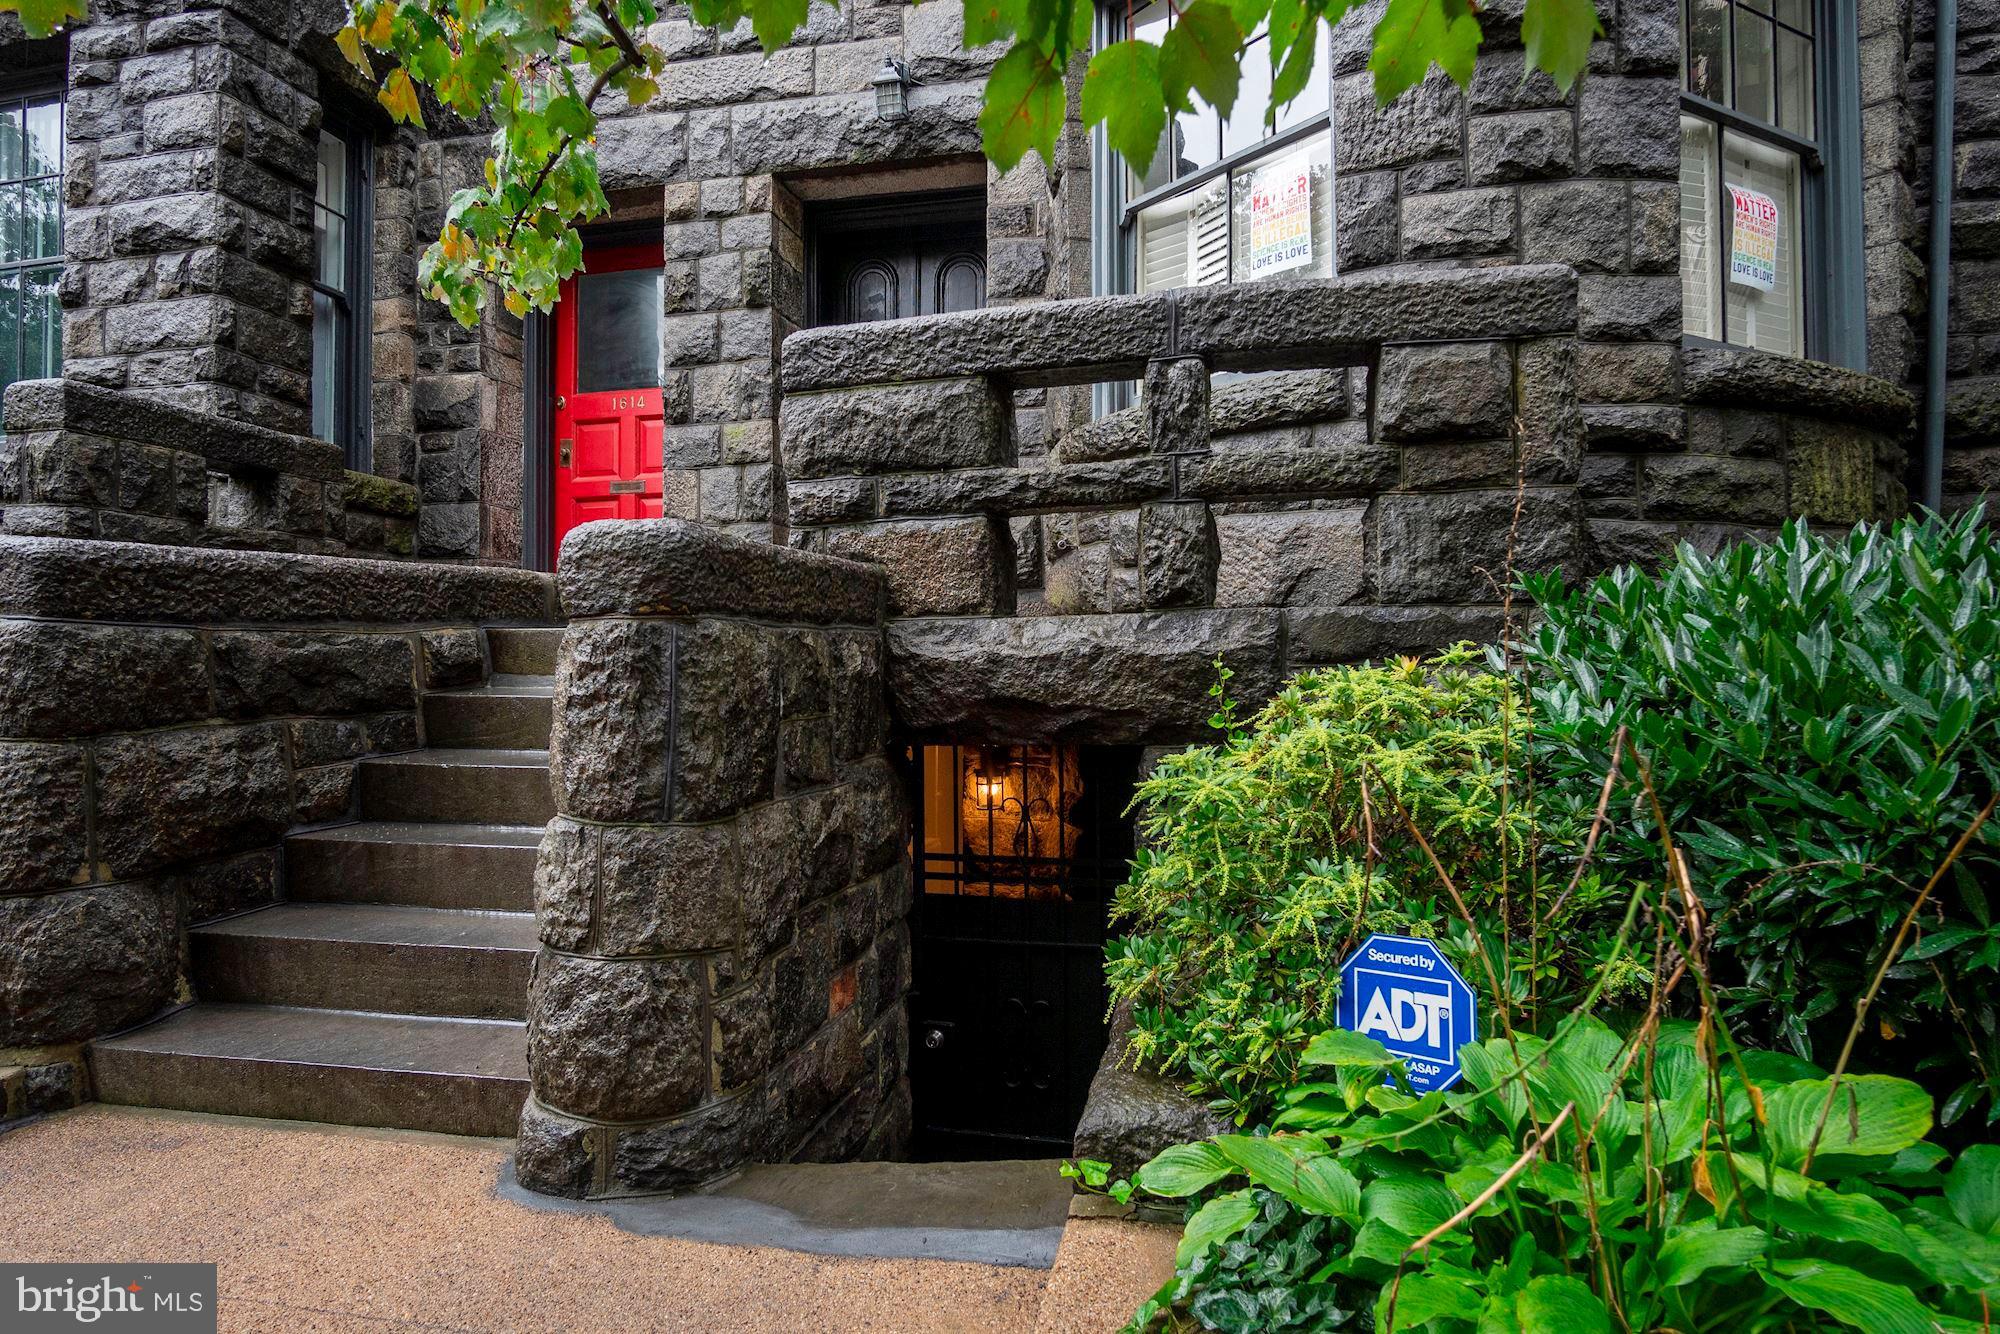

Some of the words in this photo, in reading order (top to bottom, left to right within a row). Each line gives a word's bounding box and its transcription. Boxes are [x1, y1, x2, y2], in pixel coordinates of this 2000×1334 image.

[1736, 195, 1776, 223] MATTER
[1252, 254, 1273, 271] LOVE
[1275, 251, 1283, 263] IS
[1286, 244, 1309, 260] LOVE
[1733, 261, 1751, 276] LOVE
[1752, 266, 1759, 278] IS
[612, 395, 646, 411] 1614
[1367, 947, 1419, 967] Secured
[1419, 954, 1436, 972] by
[1358, 985, 1451, 1048] ADT
